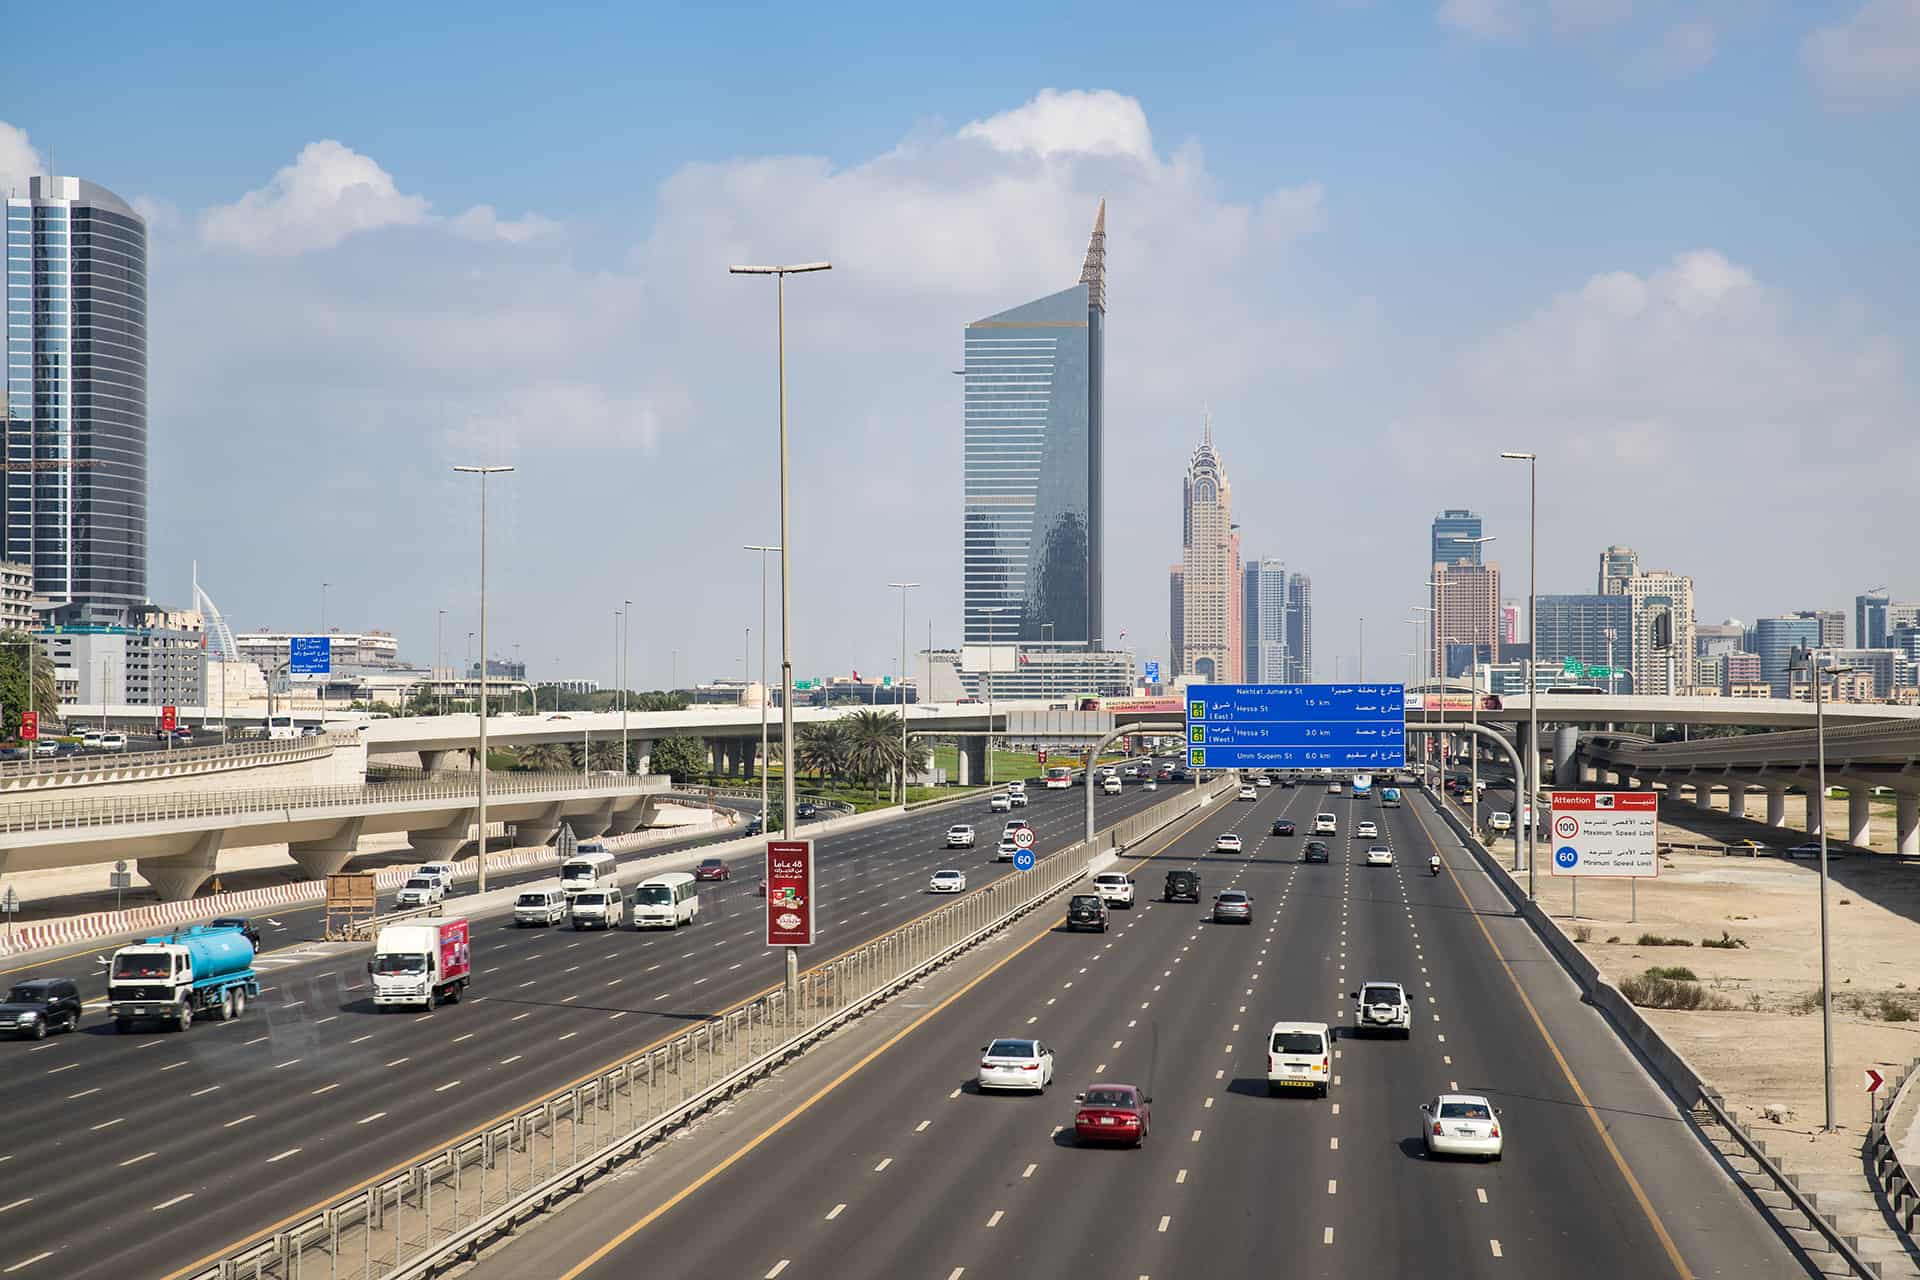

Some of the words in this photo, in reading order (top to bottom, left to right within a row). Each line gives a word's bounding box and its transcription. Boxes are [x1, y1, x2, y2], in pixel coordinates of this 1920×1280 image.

[1380, 687, 1401, 696] شارع
[1380, 704, 1400, 713] شارع
[1381, 728, 1401, 736] شارع
[1381, 752, 1401, 760] شارع
[1559, 823, 1575, 831] 100
[1016, 833, 1032, 842] 100
[1018, 856, 1030, 864] 60
[1560, 853, 1574, 861] 60
